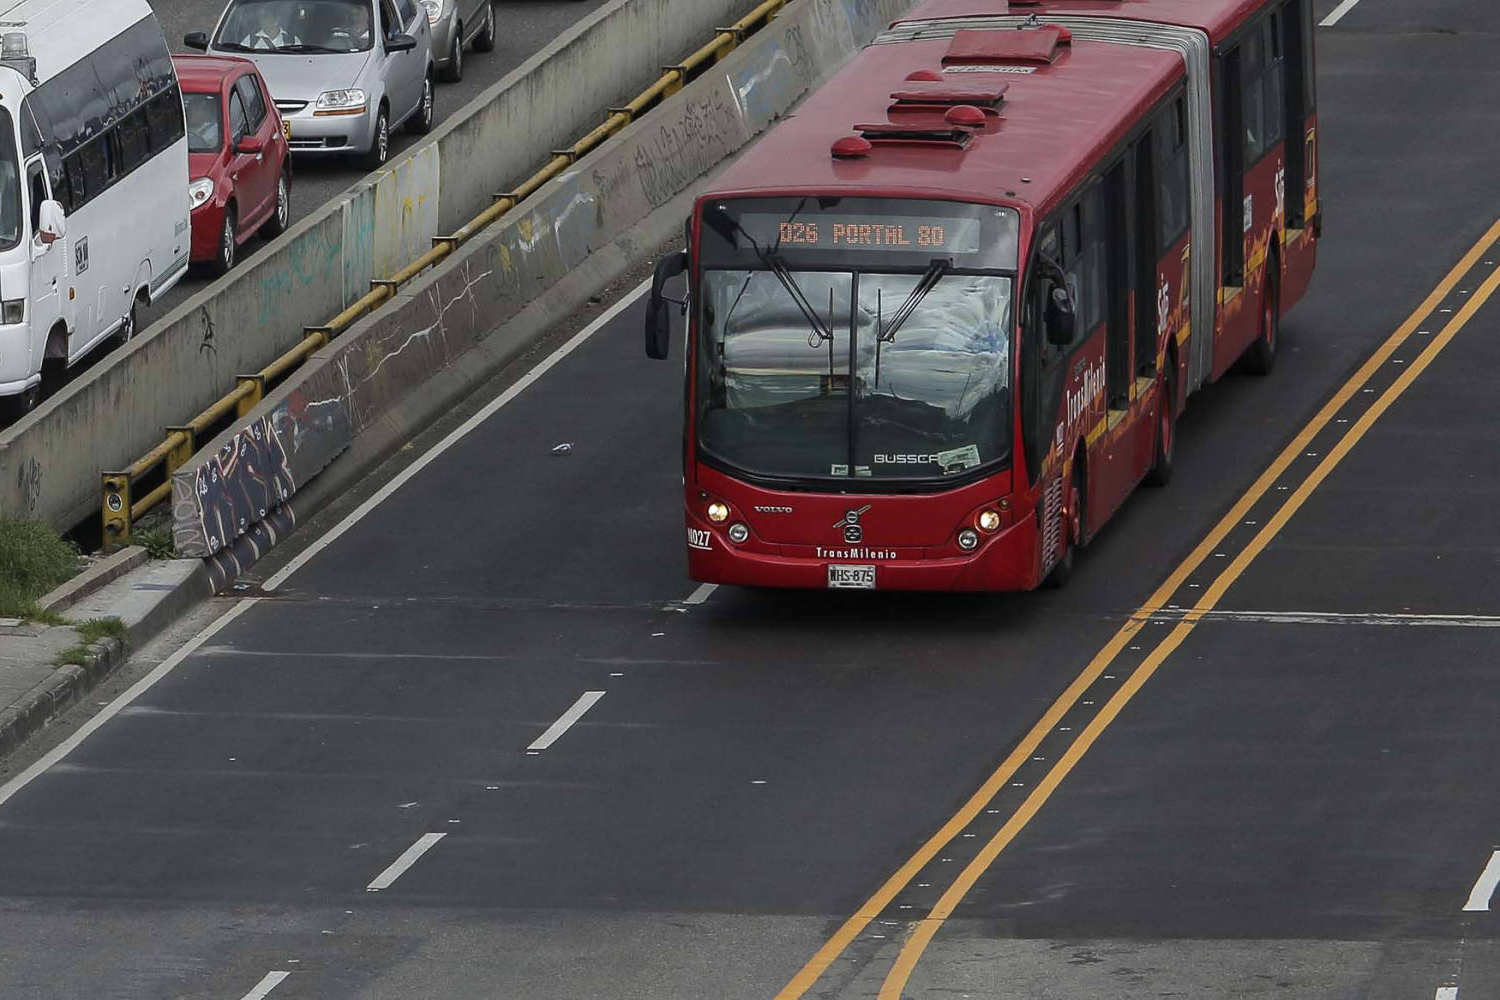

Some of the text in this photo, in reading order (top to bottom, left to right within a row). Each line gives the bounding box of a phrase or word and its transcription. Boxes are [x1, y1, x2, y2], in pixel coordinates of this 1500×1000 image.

[832, 223, 911, 247] PORTAL
[753, 505, 793, 513] VOLVO
[815, 546, 898, 560] TransMilenio
